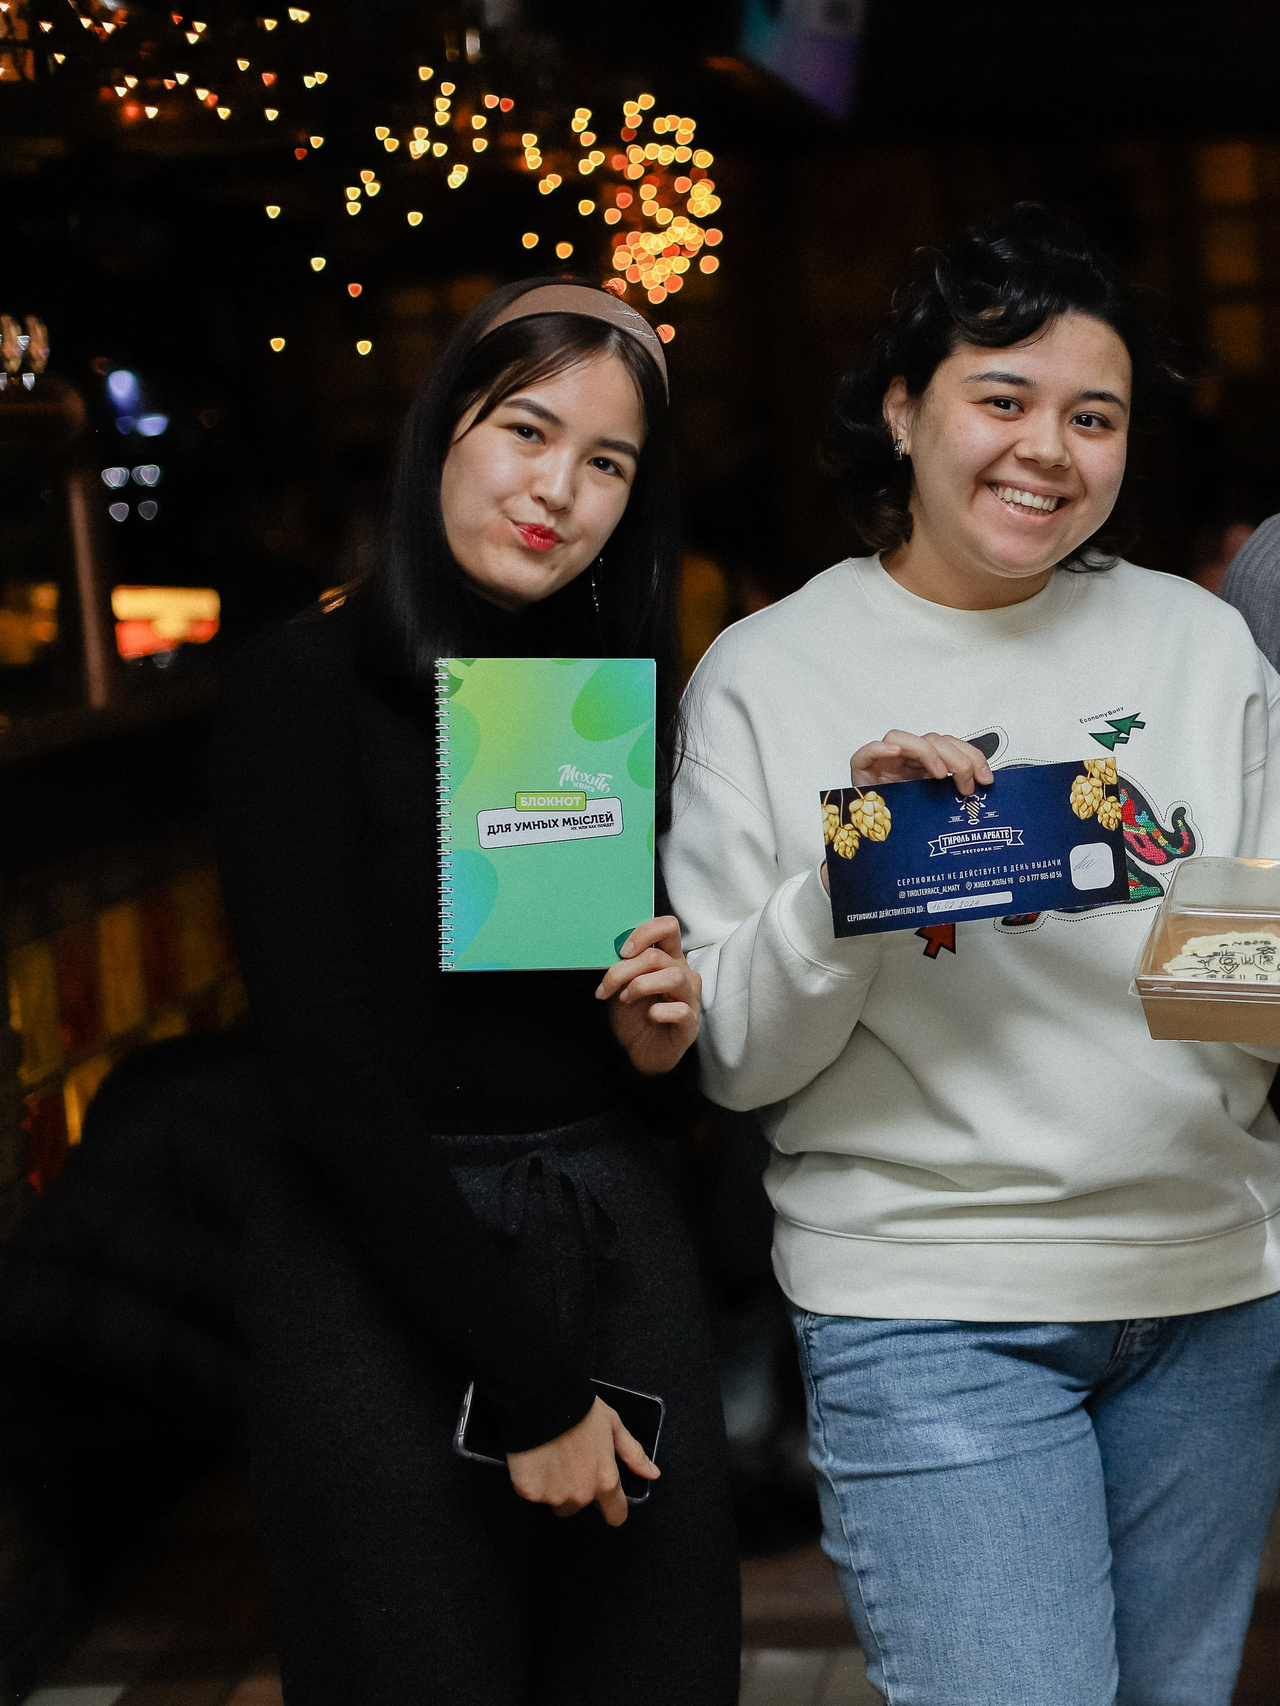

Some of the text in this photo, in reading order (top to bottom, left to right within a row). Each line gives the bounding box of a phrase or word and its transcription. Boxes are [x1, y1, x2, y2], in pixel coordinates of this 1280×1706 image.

[573, 781, 595, 793] КВИЗ
[519, 796, 582, 807] БЛОКНОТ
[487, 811, 615, 836] ДЛЯ УМНЫХ МЫСЛЕЙ
[942, 829, 1010, 846] ТИРОЛЬ НА АРБАТЕ
[962, 847, 992, 855] РЕСТОРАН
[897, 859, 1062, 887] СЕРТИФИКАТ НЕ ДЕЙСТВУЕТ В ДЕНЬ ВЫДАЧИ
[944, 901, 955, 910] 02
[846, 911, 879, 923] СЕРТИФИКАТ
[878, 906, 916, 919] ДЕЙСТВИТЕЛЕН
